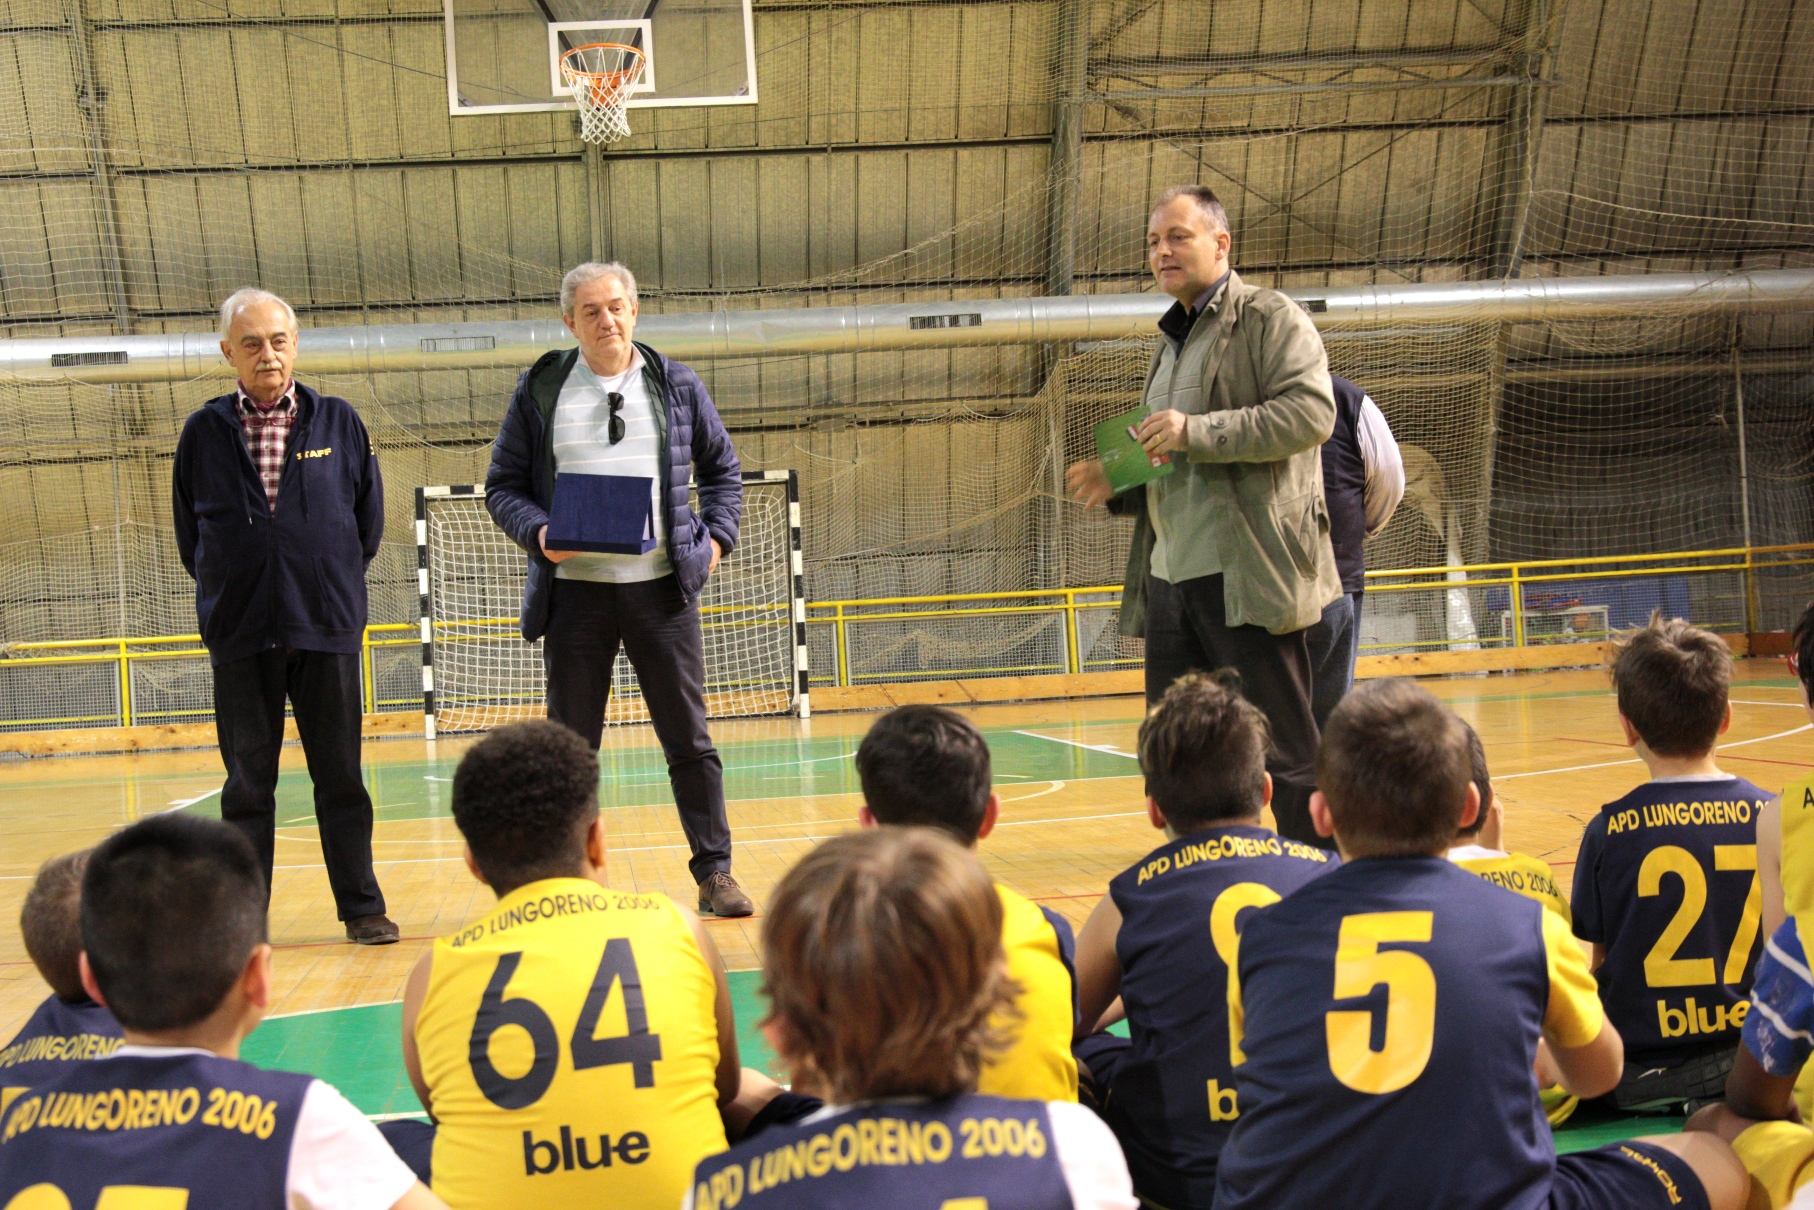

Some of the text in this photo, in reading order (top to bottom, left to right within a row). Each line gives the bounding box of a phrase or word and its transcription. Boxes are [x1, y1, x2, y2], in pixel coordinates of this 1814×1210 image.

[296, 447, 332, 460] STAFF
[1607, 809, 1640, 835] APD
[1643, 800, 1751, 828] LUNGORENO
[1137, 857, 1171, 886] APD
[1174, 835, 1283, 869] LUNGORENO
[452, 924, 485, 948] APD
[490, 894, 608, 934] LUNGORENO
[1638, 844, 1762, 987] 27
[468, 937, 663, 1111] 64
[1325, 911, 1437, 1095] 5
[38, 1086, 201, 1131] LUNGORENO
[202, 1087, 278, 1140] 2006
[749, 1118, 953, 1195] LUNGORENO
[959, 1117, 1047, 1159] 2006
